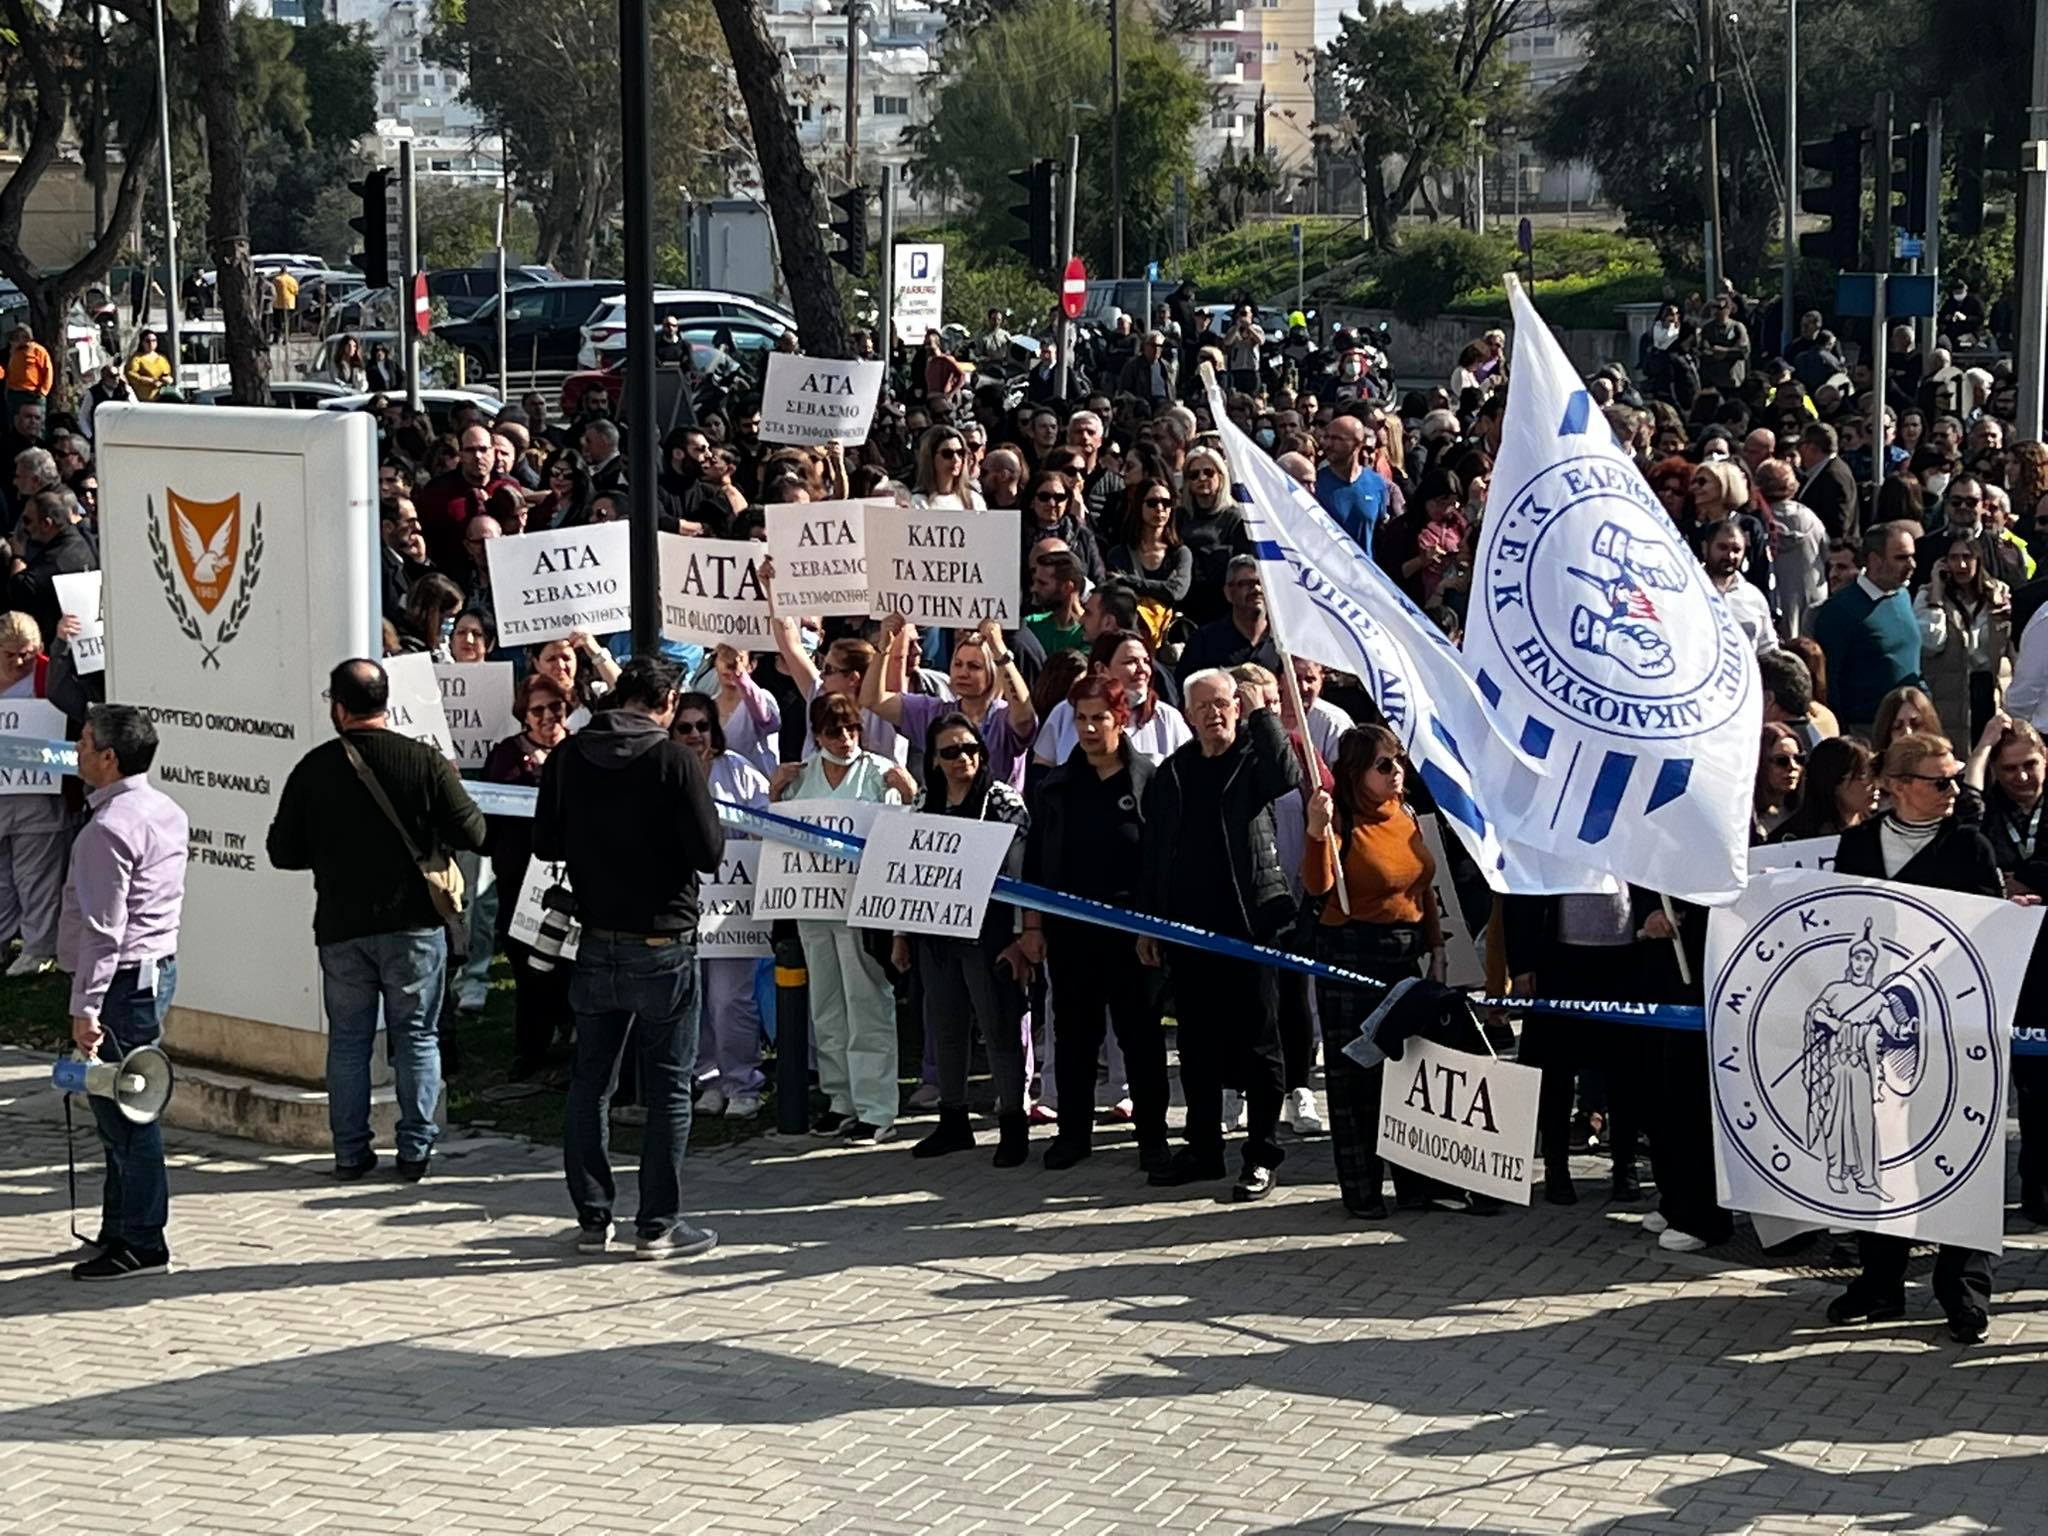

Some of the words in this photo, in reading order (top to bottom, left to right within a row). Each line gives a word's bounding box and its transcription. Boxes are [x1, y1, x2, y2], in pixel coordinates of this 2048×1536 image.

[800, 373, 855, 395] ΑΤΑ
[785, 400, 860, 418] ΣΕΒΑΣΜΟ
[764, 421, 785, 433] ΣΤΑ
[797, 519, 857, 547] ΑΤΑ
[908, 525, 966, 548] ΚΑΤΩ
[532, 544, 601, 575] ΑΤΑ
[892, 558, 916, 581] ΤΑ
[921, 560, 983, 584] ΧΕΡΙΑ
[681, 552, 769, 601] ΑΤΑ
[522, 579, 617, 605] ΣΕΒΑΣΜΟ
[777, 592, 798, 606] ΣΤΑ
[875, 591, 914, 616] ΑΠΟ
[918, 594, 963, 618] ΤΗΝ
[968, 597, 1008, 620] ΑΤΑ
[503, 621, 530, 635] ΣΤΑ
[666, 605, 687, 627] ΣΤΗ
[688, 610, 761, 636] ΦΙΛΟΣΟΦΙΑ
[1512, 636, 1703, 729] ΔΙΚΑΙΟΣΥΝΗ
[205, 713, 295, 740] ΟΙΚΟΝΟΜΙΚΩΝ
[160, 765, 205, 786] MALİYE
[908, 829, 962, 854] ΚΑΤΩ
[201, 849, 256, 872] FINANCE
[783, 852, 803, 874] ΤΑ
[886, 861, 907, 884] ΤΑ
[910, 863, 964, 891] ΧΕΡΙΑ
[761, 887, 798, 910] ΑΠΟ
[802, 887, 847, 910] ΤΗΝ
[856, 895, 896, 919] ΑΠΟ
[899, 898, 940, 924] ΤΗΝ
[941, 903, 974, 928] ΑΤΑ
[1404, 1058, 1499, 1134] ΑΤΑ
[1383, 1115, 1407, 1146] ΣΤΗ
[1408, 1126, 1487, 1173] ΦΙΛΟΣΟΦΙΑ
[1491, 1152, 1524, 1182] ΤΗΣ
